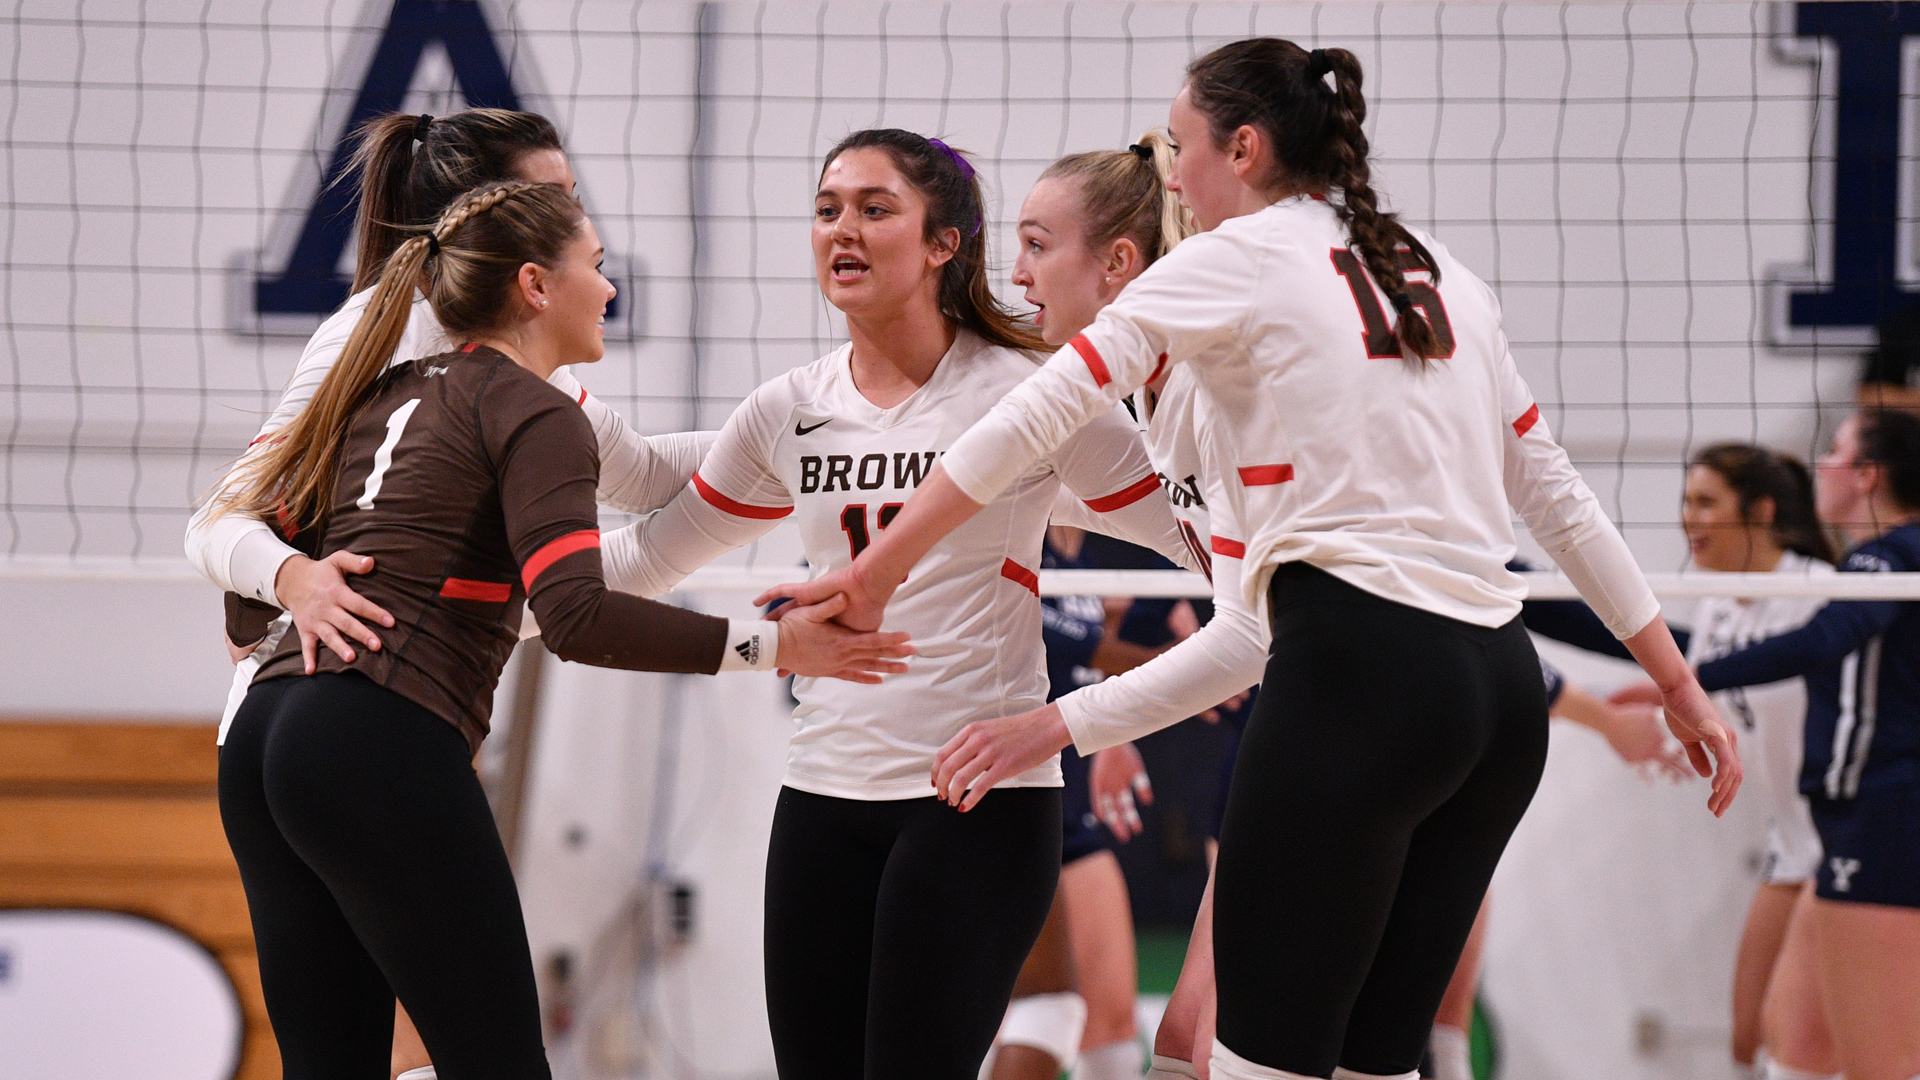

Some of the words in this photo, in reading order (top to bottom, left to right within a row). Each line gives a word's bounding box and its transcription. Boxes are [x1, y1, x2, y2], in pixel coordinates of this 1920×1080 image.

[356, 398, 421, 510] 1
[800, 451, 946, 494] BROW
[840, 502, 909, 584] 1
[750, 634, 760, 665] adidas
[1830, 856, 1861, 893] Y
